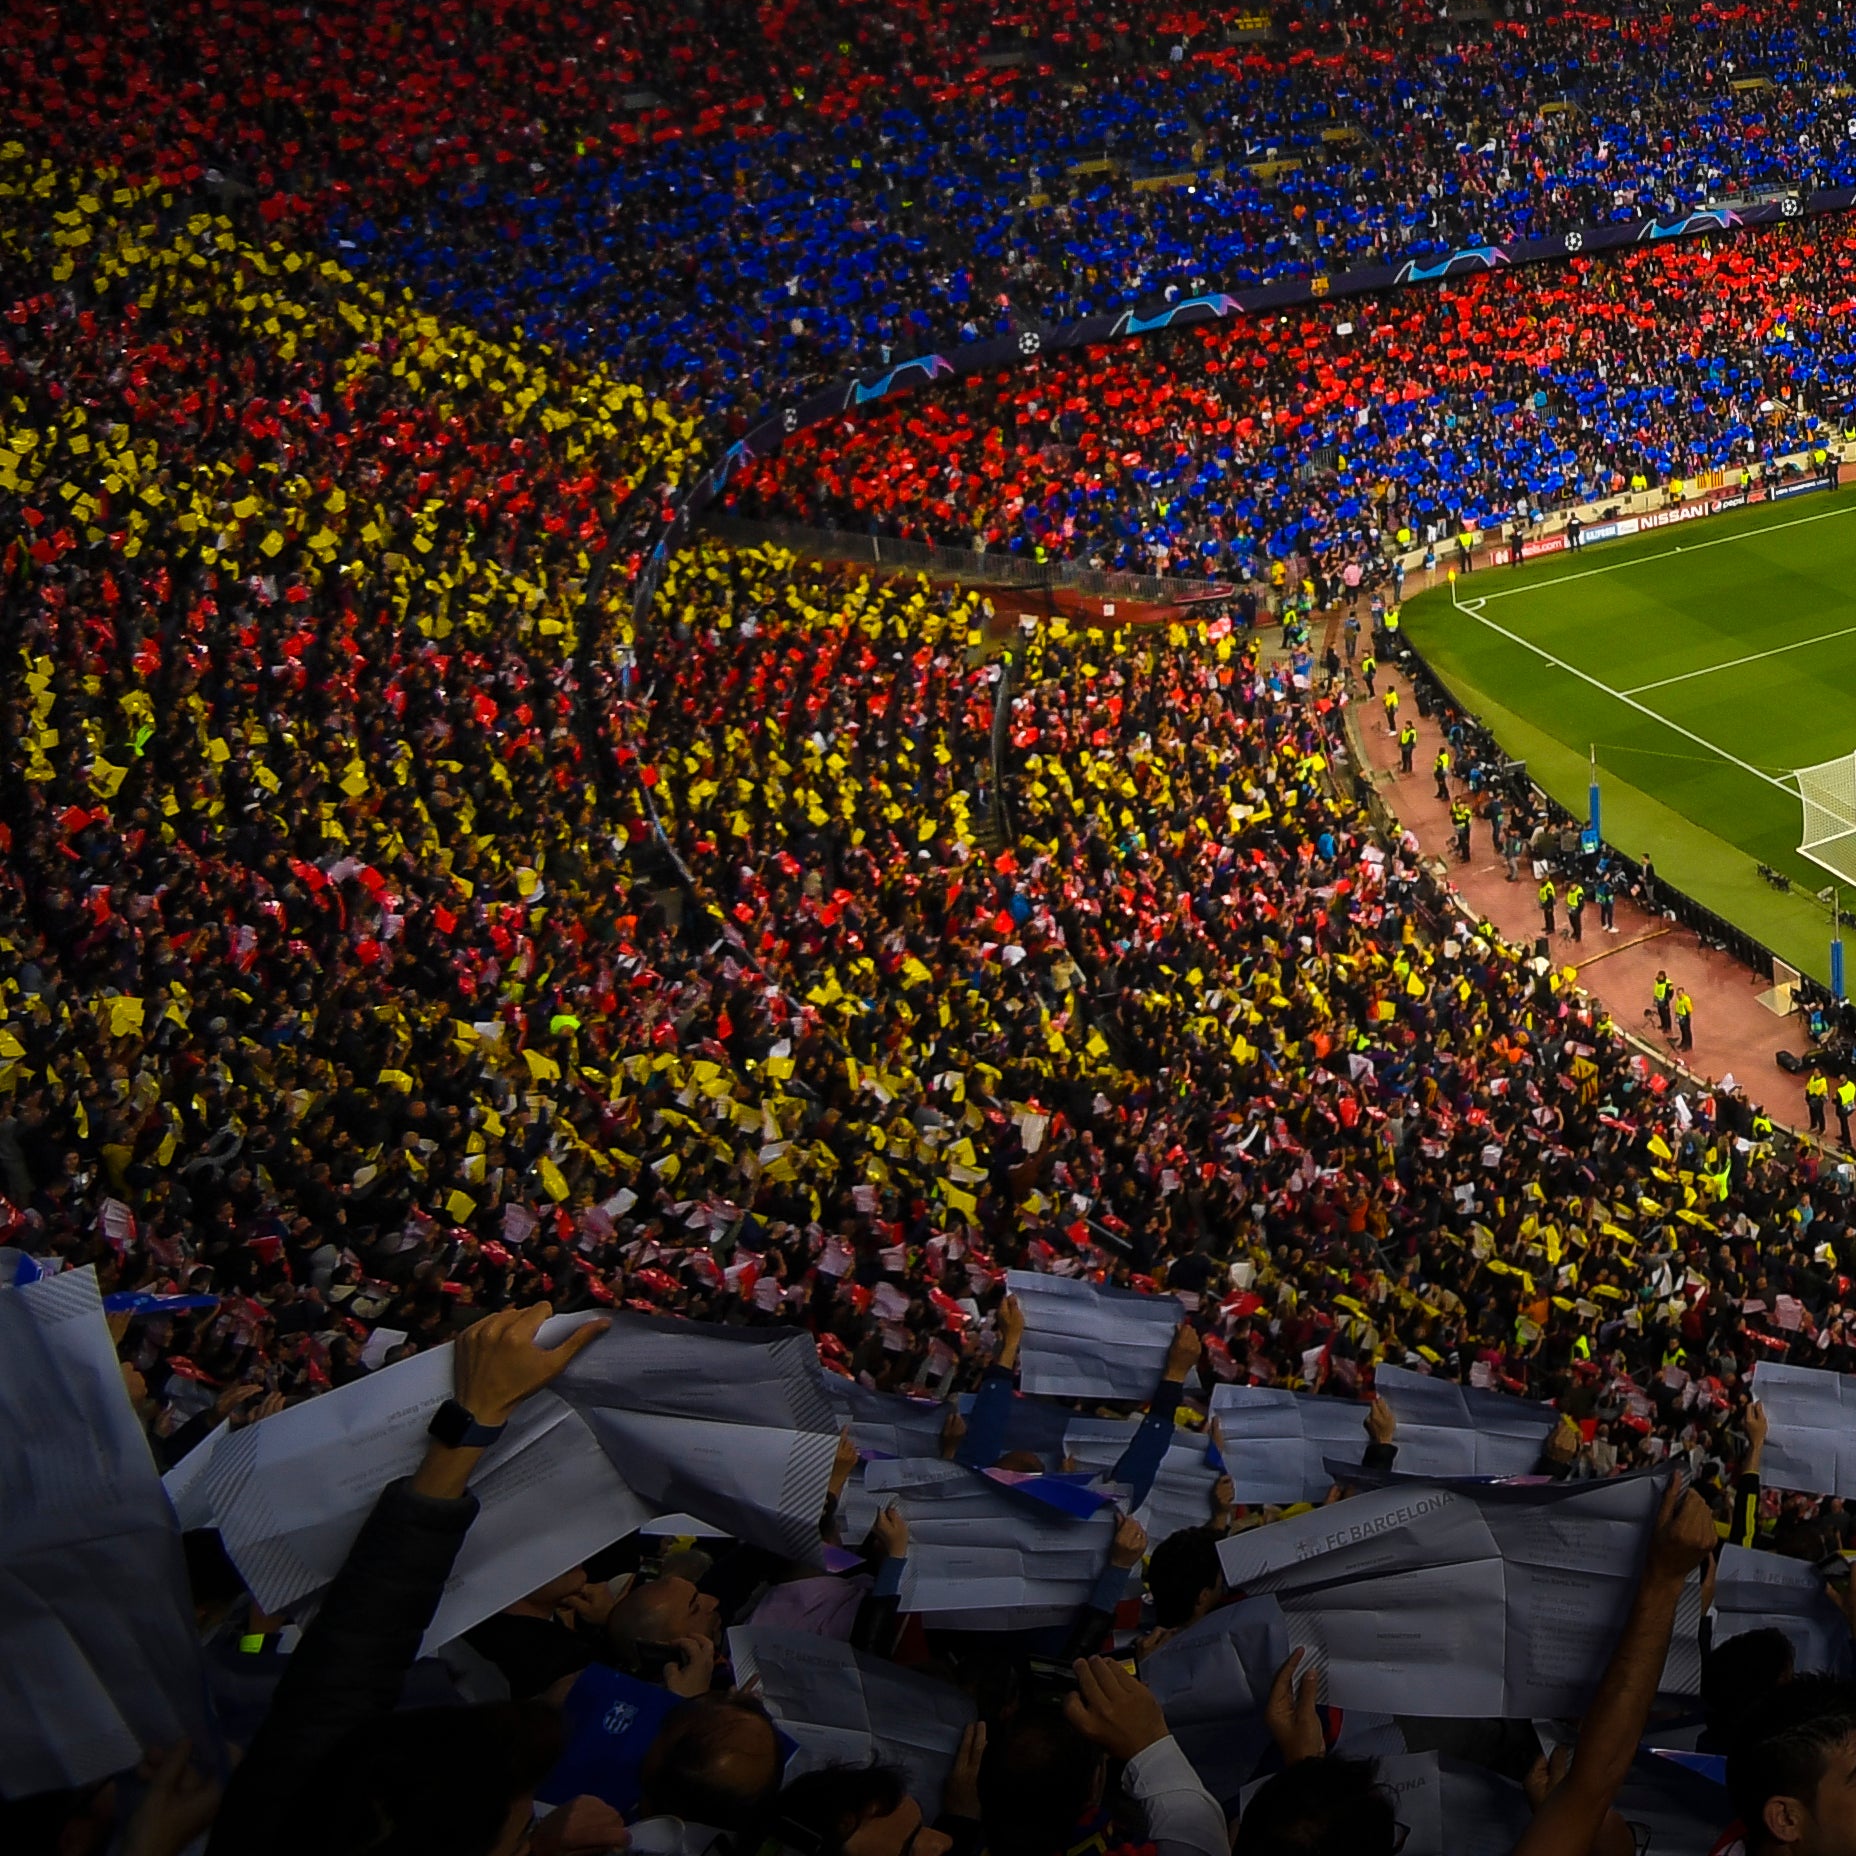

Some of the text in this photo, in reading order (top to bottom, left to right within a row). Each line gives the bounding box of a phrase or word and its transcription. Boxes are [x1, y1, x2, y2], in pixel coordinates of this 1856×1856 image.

[1640, 504, 1703, 530] NISSAN
[1325, 1491, 1455, 1550] FC BARCELONA
